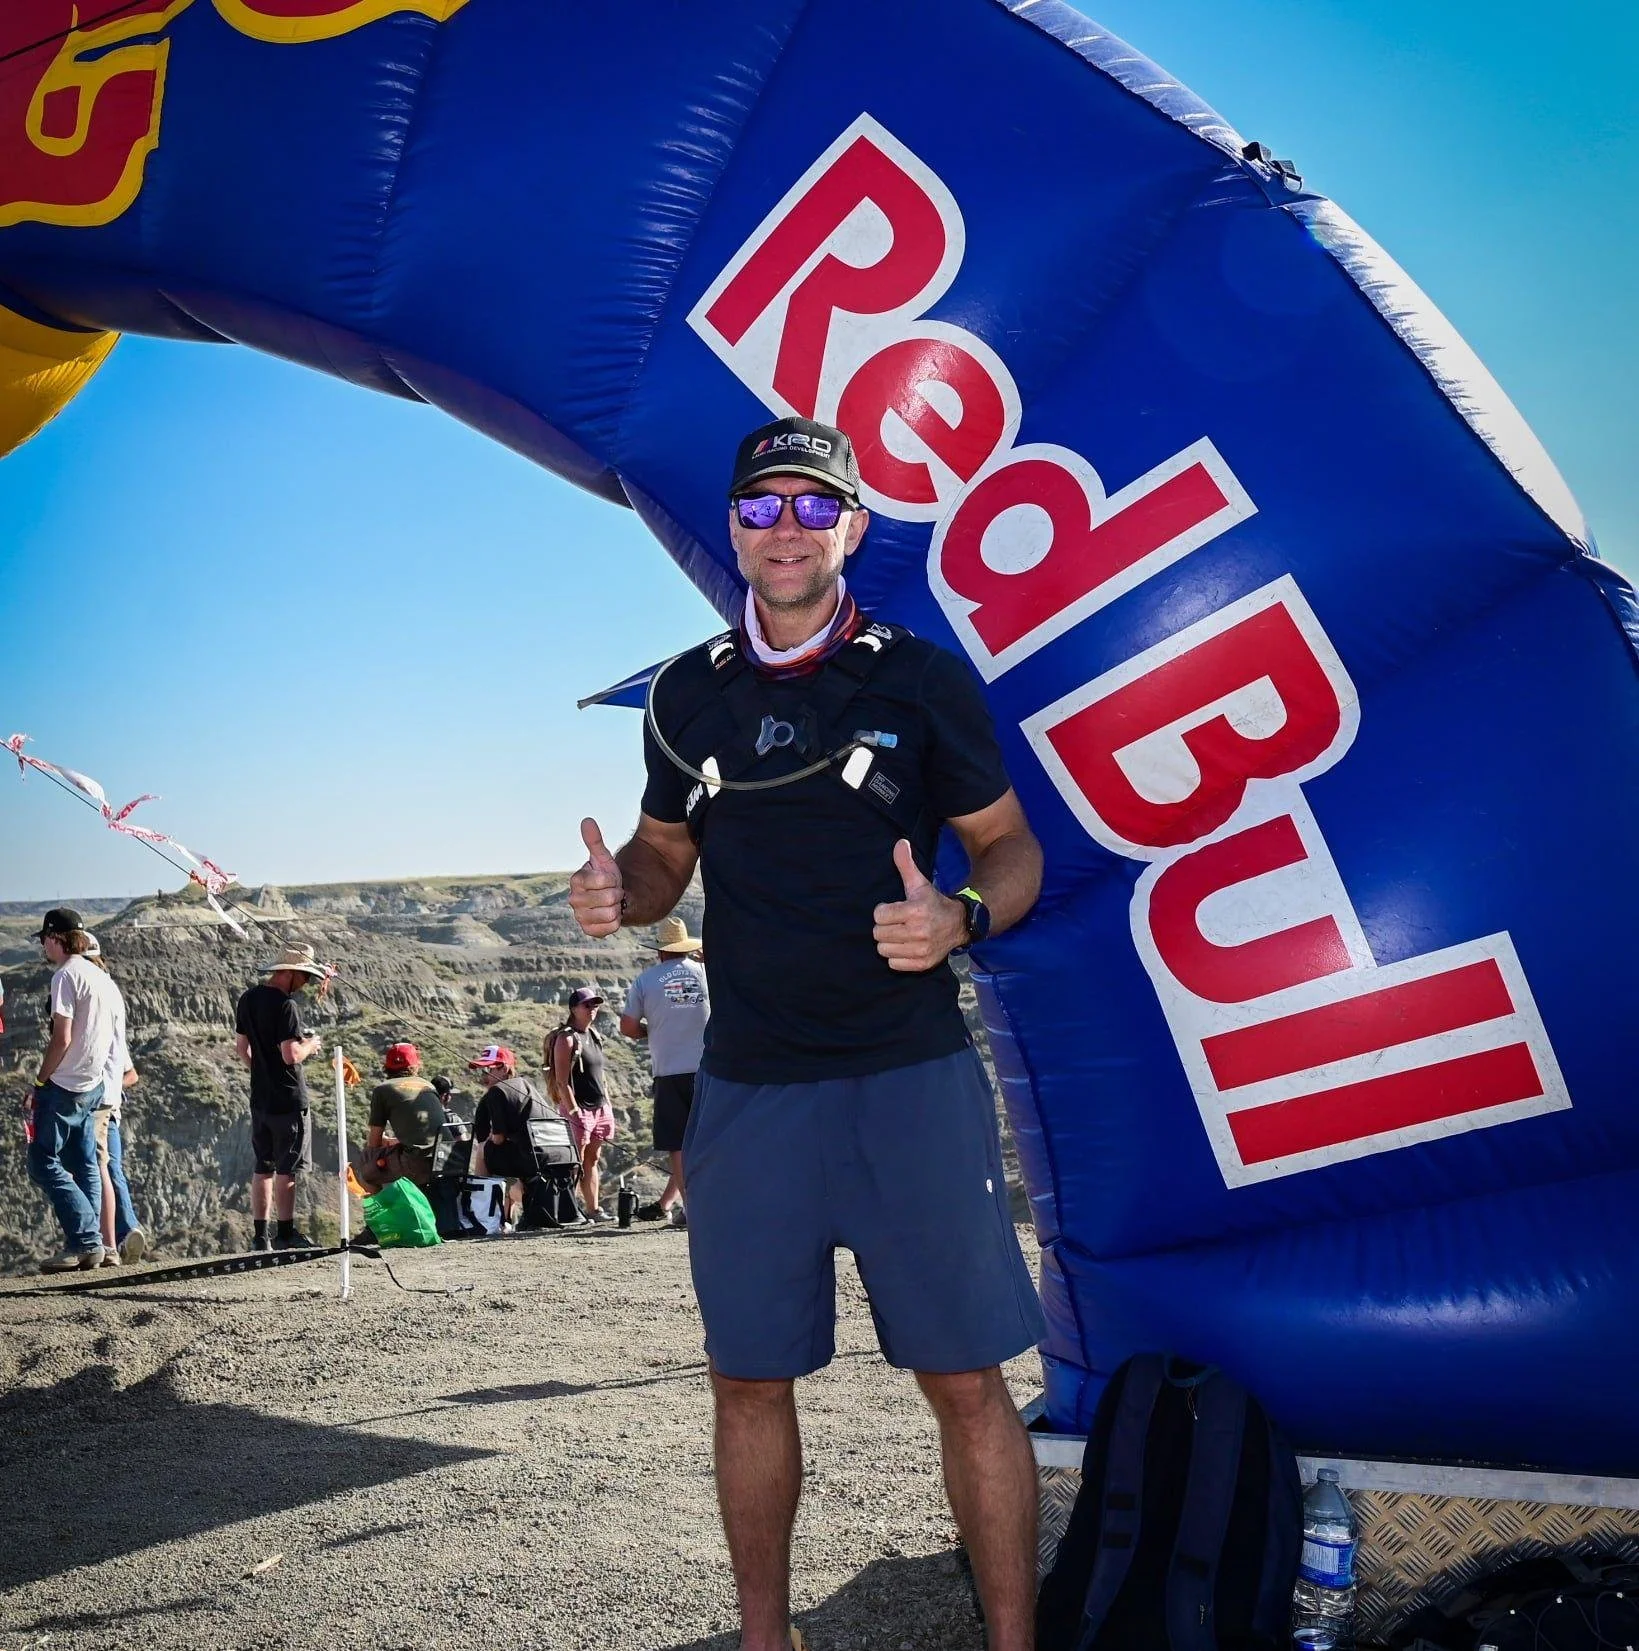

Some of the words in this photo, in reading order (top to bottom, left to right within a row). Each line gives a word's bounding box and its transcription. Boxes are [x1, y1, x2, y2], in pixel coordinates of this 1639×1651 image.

[772, 433, 832, 453] KRD
[705, 136, 1230, 656] Red
[1047, 602, 1544, 1167] Bull
[873, 778, 896, 798] DANCING
[658, 972, 673, 983] OLD
